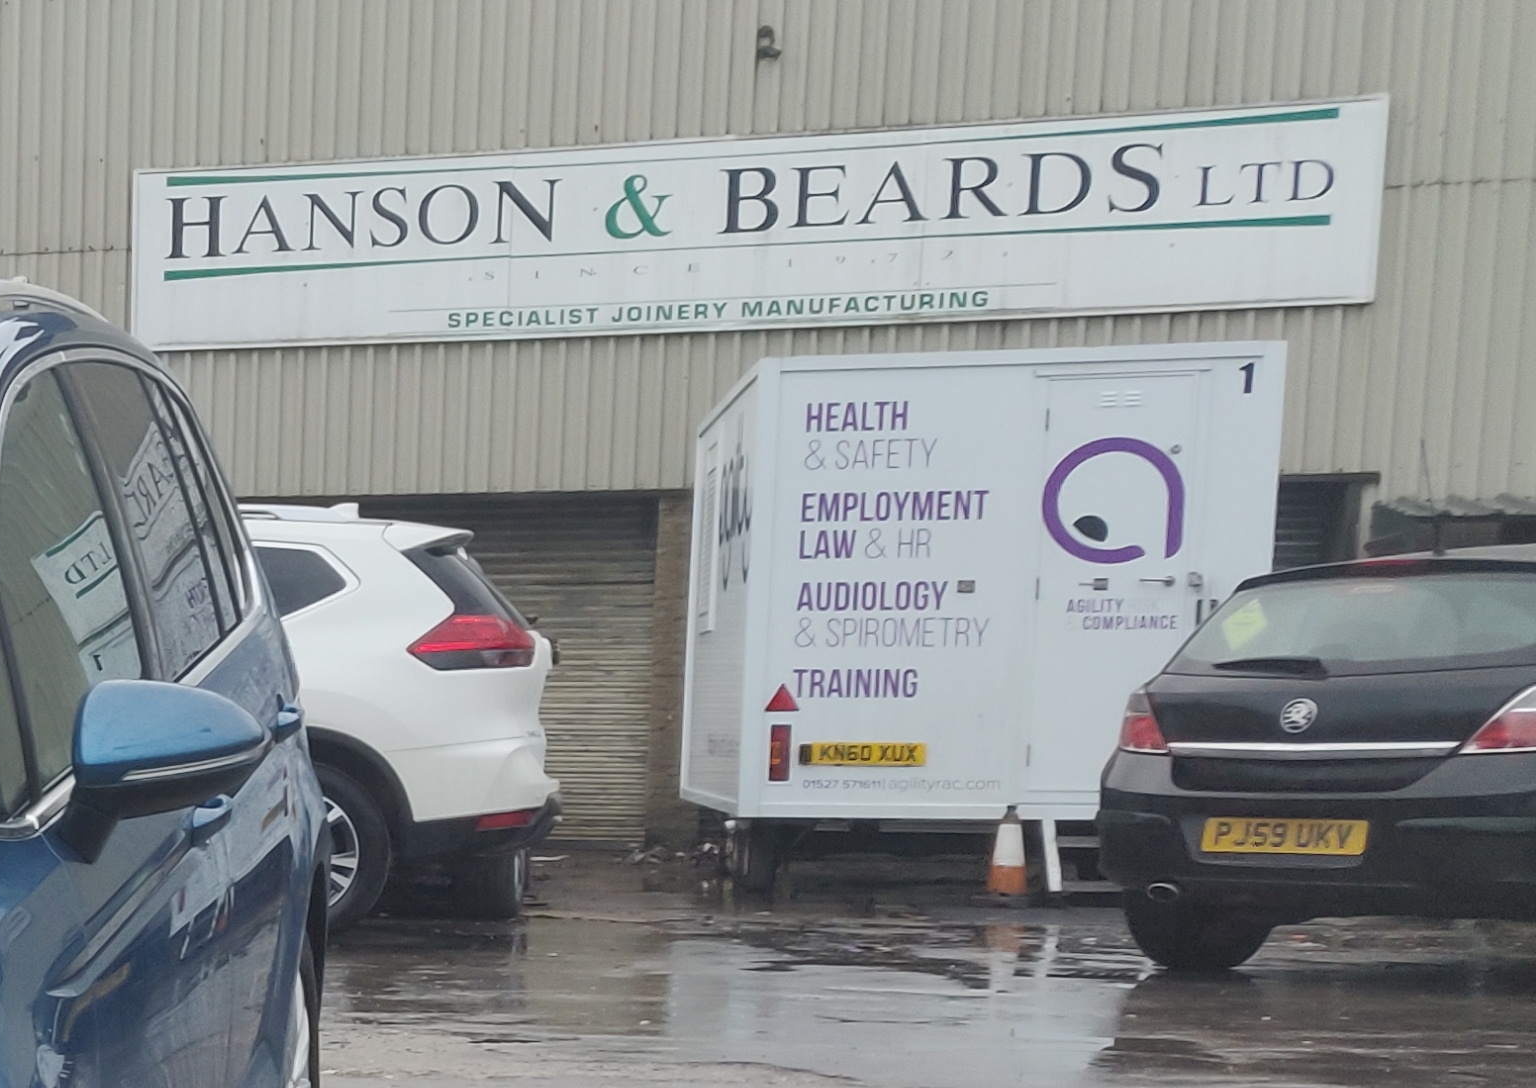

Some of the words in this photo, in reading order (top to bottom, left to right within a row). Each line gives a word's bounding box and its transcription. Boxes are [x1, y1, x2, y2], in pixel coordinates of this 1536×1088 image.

[164, 178, 563, 259] HANSON
[604, 173, 673, 239] &
[716, 142, 1164, 235] BEARDS
[1192, 159, 1335, 207] LTD
[483, 260, 701, 281] SINCE
[447, 307, 600, 329] SPECIALIST
[611, 301, 729, 324] JOINERY
[740, 290, 990, 319] MANUFACTURING
[1238, 361, 1255, 394] 1
[805, 400, 909, 432] HEALTH
[803, 439, 827, 471] &
[834, 437, 938, 470] SAFETY
[800, 489, 990, 523] EMPLOYMENT
[798, 529, 857, 560] LAW
[864, 527, 888, 559] &
[897, 527, 932, 559] HR
[796, 580, 949, 612] AUDIOLOGY
[1066, 598, 1125, 614] AGILITY
[794, 616, 818, 648] &
[825, 616, 991, 648] SPIROMETRY
[1082, 614, 1179, 631] COMPLIANCE
[792, 668, 919, 699] TRAINING
[818, 743, 873, 762] KN60
[877, 743, 919, 762] XUX
[1213, 821, 1288, 848] PJ59
